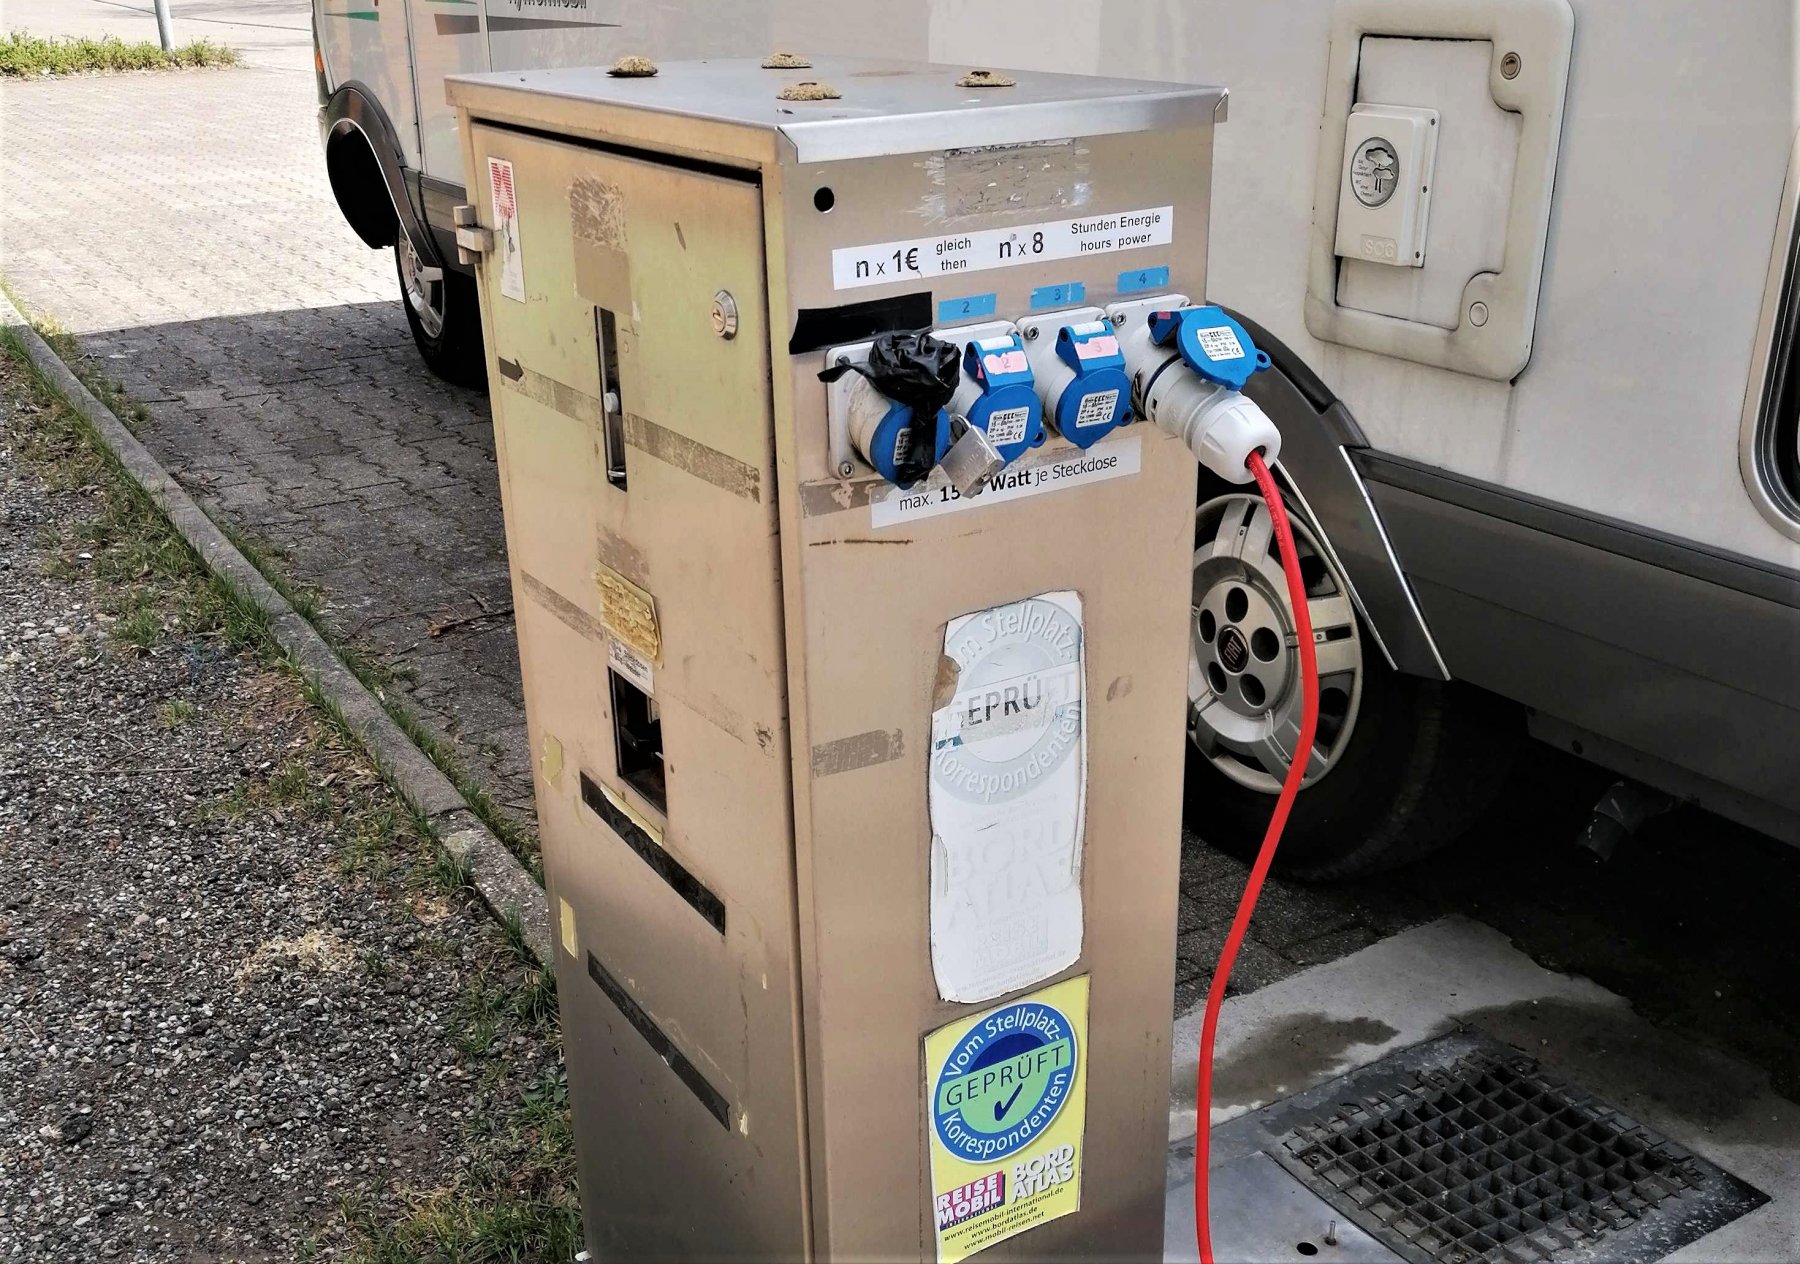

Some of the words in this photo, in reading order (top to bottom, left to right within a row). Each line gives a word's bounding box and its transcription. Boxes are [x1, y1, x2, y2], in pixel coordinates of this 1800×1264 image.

[1071, 219, 1116, 235] Stunden
[1120, 212, 1161, 228] Energie
[936, 237, 972, 255] gleich
[999, 241, 1012, 259] n
[1032, 232, 1044, 253] 8
[1080, 238, 1112, 252] hours
[1118, 233, 1152, 249] power
[856, 260, 870, 278] n
[892, 248, 919, 273] 1€
[941, 259, 967, 271] then
[1138, 273, 1146, 284] 4
[961, 301, 970, 314] 2
[1054, 288, 1061, 301] 3
[1002, 357, 1011, 368] 2
[900, 494, 934, 511] max.
[940, 481, 984, 502] 15
[990, 470, 1032, 492] Watt
[1034, 468, 1048, 486] je
[1052, 455, 1117, 479] Steckdose
[1223, 635, 1242, 665] FIAT
[945, 1036, 984, 1076] Vom
[946, 1044, 1064, 1106] GEPRÜFT
[942, 1072, 1067, 1158] Korrespondenten
[1013, 1144, 1075, 1184] BORD
[937, 1173, 998, 1211] REISE
[1012, 1161, 1074, 1203] ATLAS
[938, 1188, 1002, 1226] MOBIL
[944, 1186, 1064, 1242] www.reisemobil-international.de
[971, 1206, 1038, 1239] www.bordatlas.de
[963, 1211, 1045, 1250] www.mobil-reisen.net
